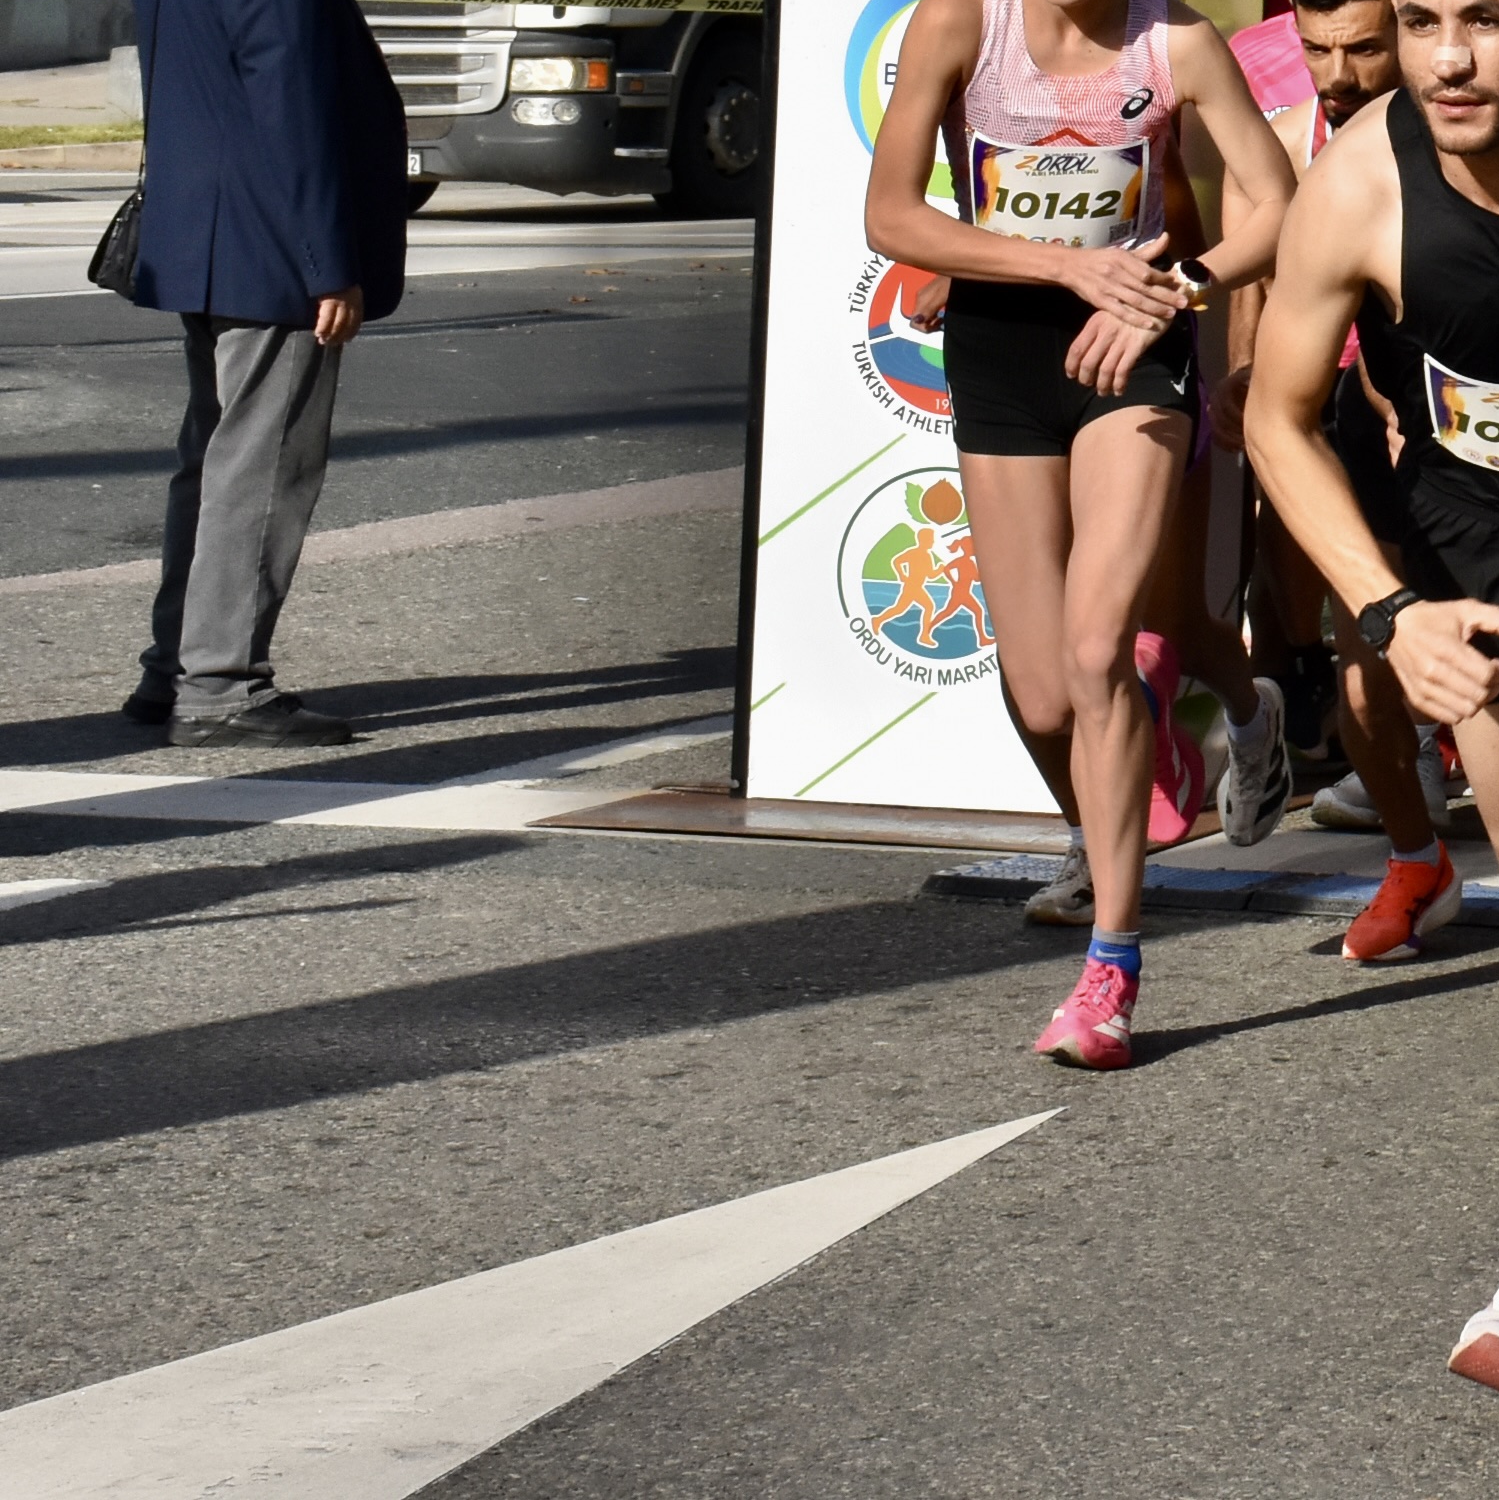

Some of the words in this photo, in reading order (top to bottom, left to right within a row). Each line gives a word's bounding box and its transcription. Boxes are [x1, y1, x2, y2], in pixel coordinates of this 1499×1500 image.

[1036, 155, 1096, 172] ORDU
[994, 186, 1122, 220] 10142
[852, 340, 895, 410] TURKISH
[849, 617, 893, 666] ORDU
[893, 656, 933, 685] YARI
